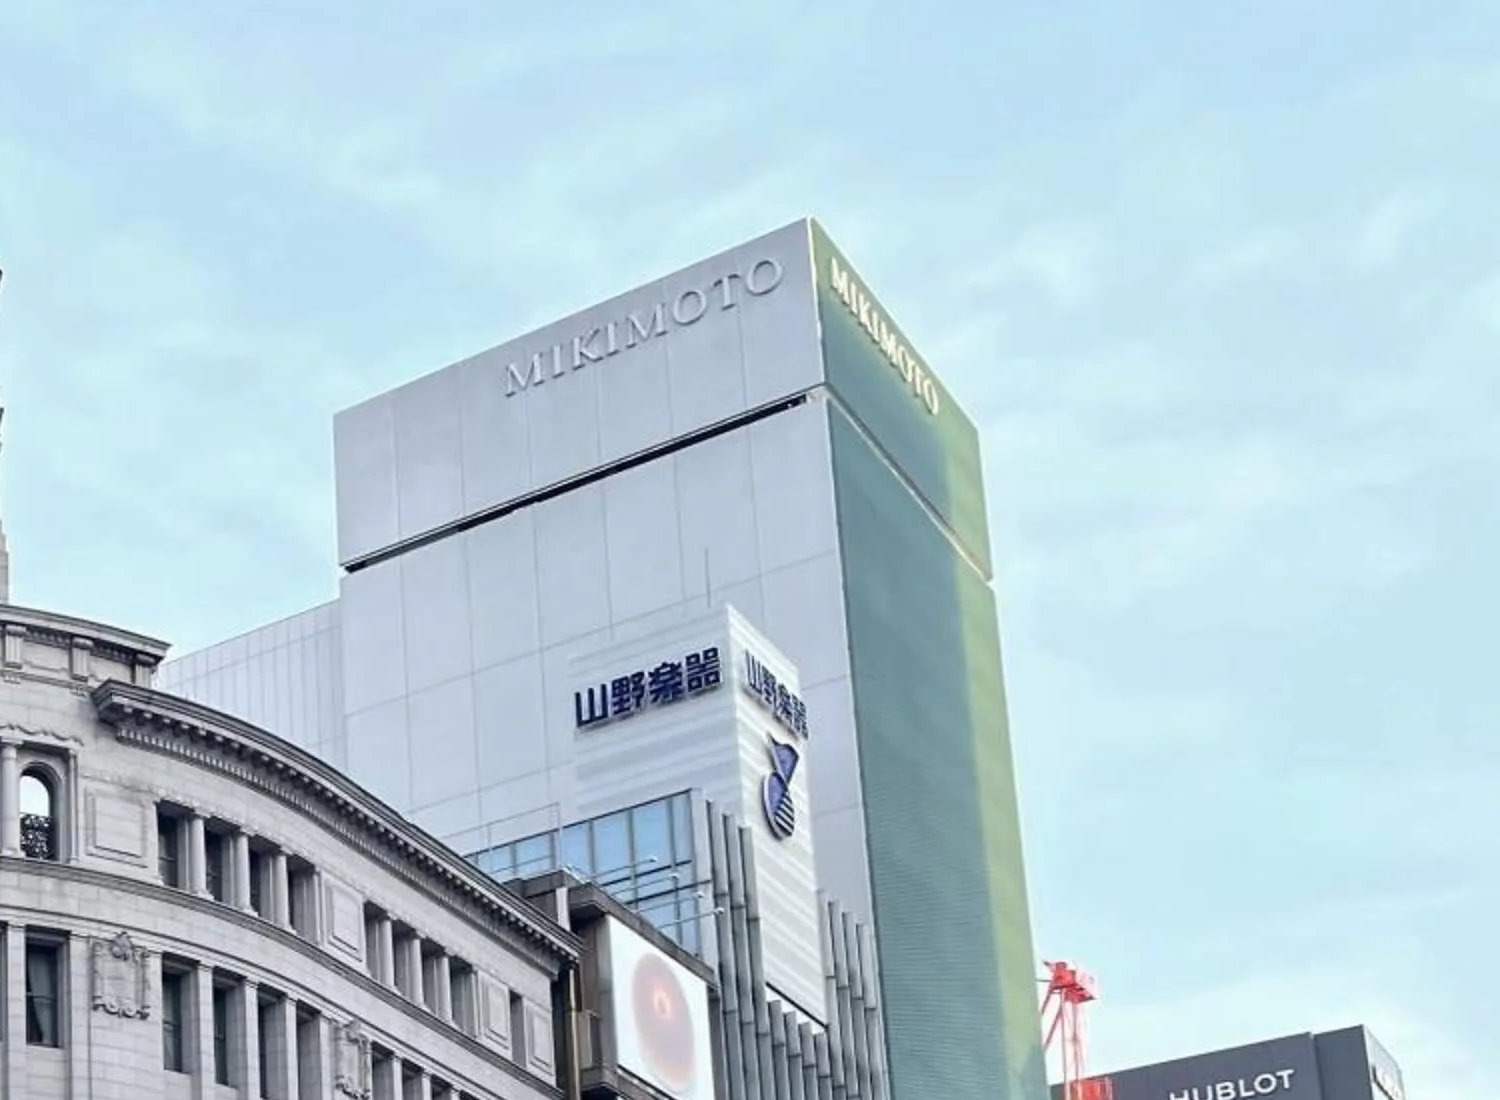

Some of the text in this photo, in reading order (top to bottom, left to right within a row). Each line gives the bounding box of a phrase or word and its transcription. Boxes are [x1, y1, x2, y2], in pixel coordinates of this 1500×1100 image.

[505, 256, 784, 398] MIKIMOTO
[829, 256, 939, 417] MIKIMOTO
[575, 647, 723, 728] 山野楽器
[745, 649, 809, 741] 山野楽器
